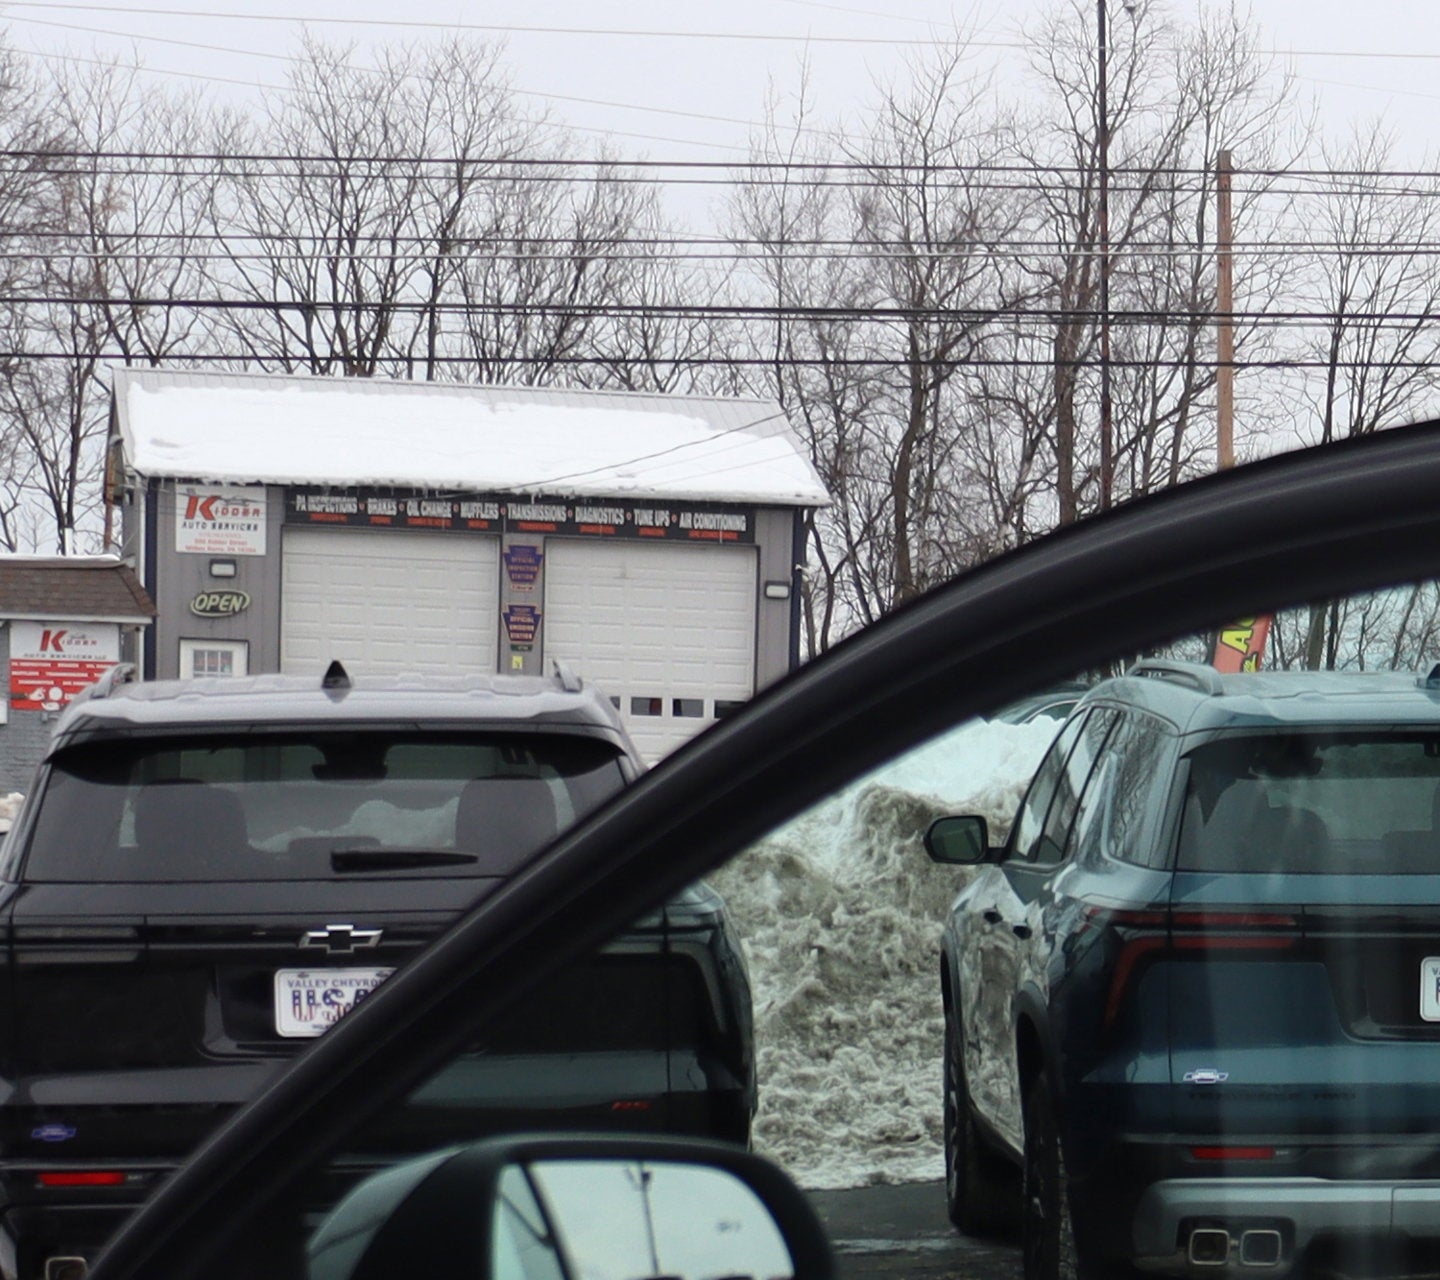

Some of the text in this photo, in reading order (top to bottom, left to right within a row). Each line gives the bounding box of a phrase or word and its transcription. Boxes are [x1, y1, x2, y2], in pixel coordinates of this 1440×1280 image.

[185, 495, 260, 521] KIDDER
[368, 498, 397, 516] BRAKES
[406, 500, 420, 517] OIL
[421, 501, 453, 518] CHANGE
[460, 502, 499, 520] MUFFLERS
[506, 503, 567, 522] TRANSMISSIONS
[575, 507, 625, 526] DIAGNOSTICS
[633, 508, 654, 526] TUNE
[655, 510, 670, 527] UPS
[679, 511, 692, 529] AIR
[693, 512, 747, 531] CONDITIONING
[182, 521, 259, 531] AUTO SERVICES
[195, 593, 244, 613] OPEN
[287, 979, 329, 988] VALLEY
